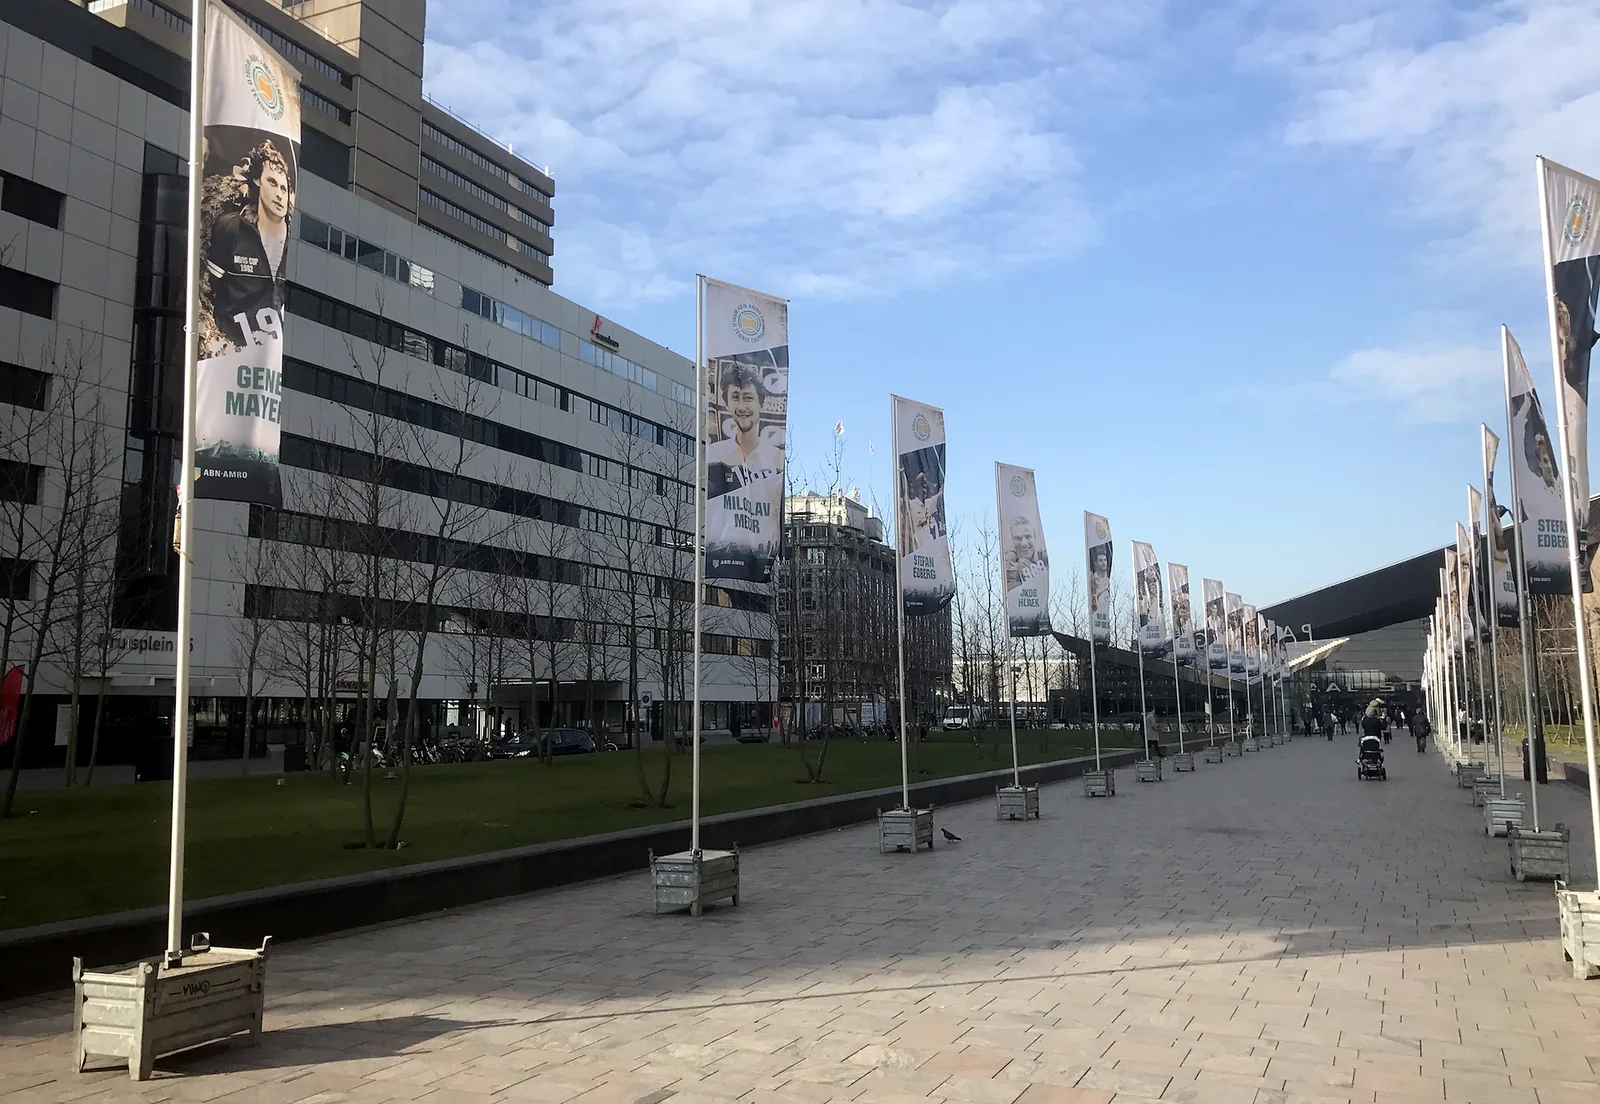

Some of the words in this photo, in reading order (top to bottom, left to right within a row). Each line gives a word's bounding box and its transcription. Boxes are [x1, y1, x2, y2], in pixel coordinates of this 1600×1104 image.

[233, 306, 284, 347] 19
[225, 390, 281, 424] MAYE
[1537, 534, 1569, 548] EDBER
[913, 554, 935, 568] STEFAN
[912, 567, 936, 580] EDBERG
